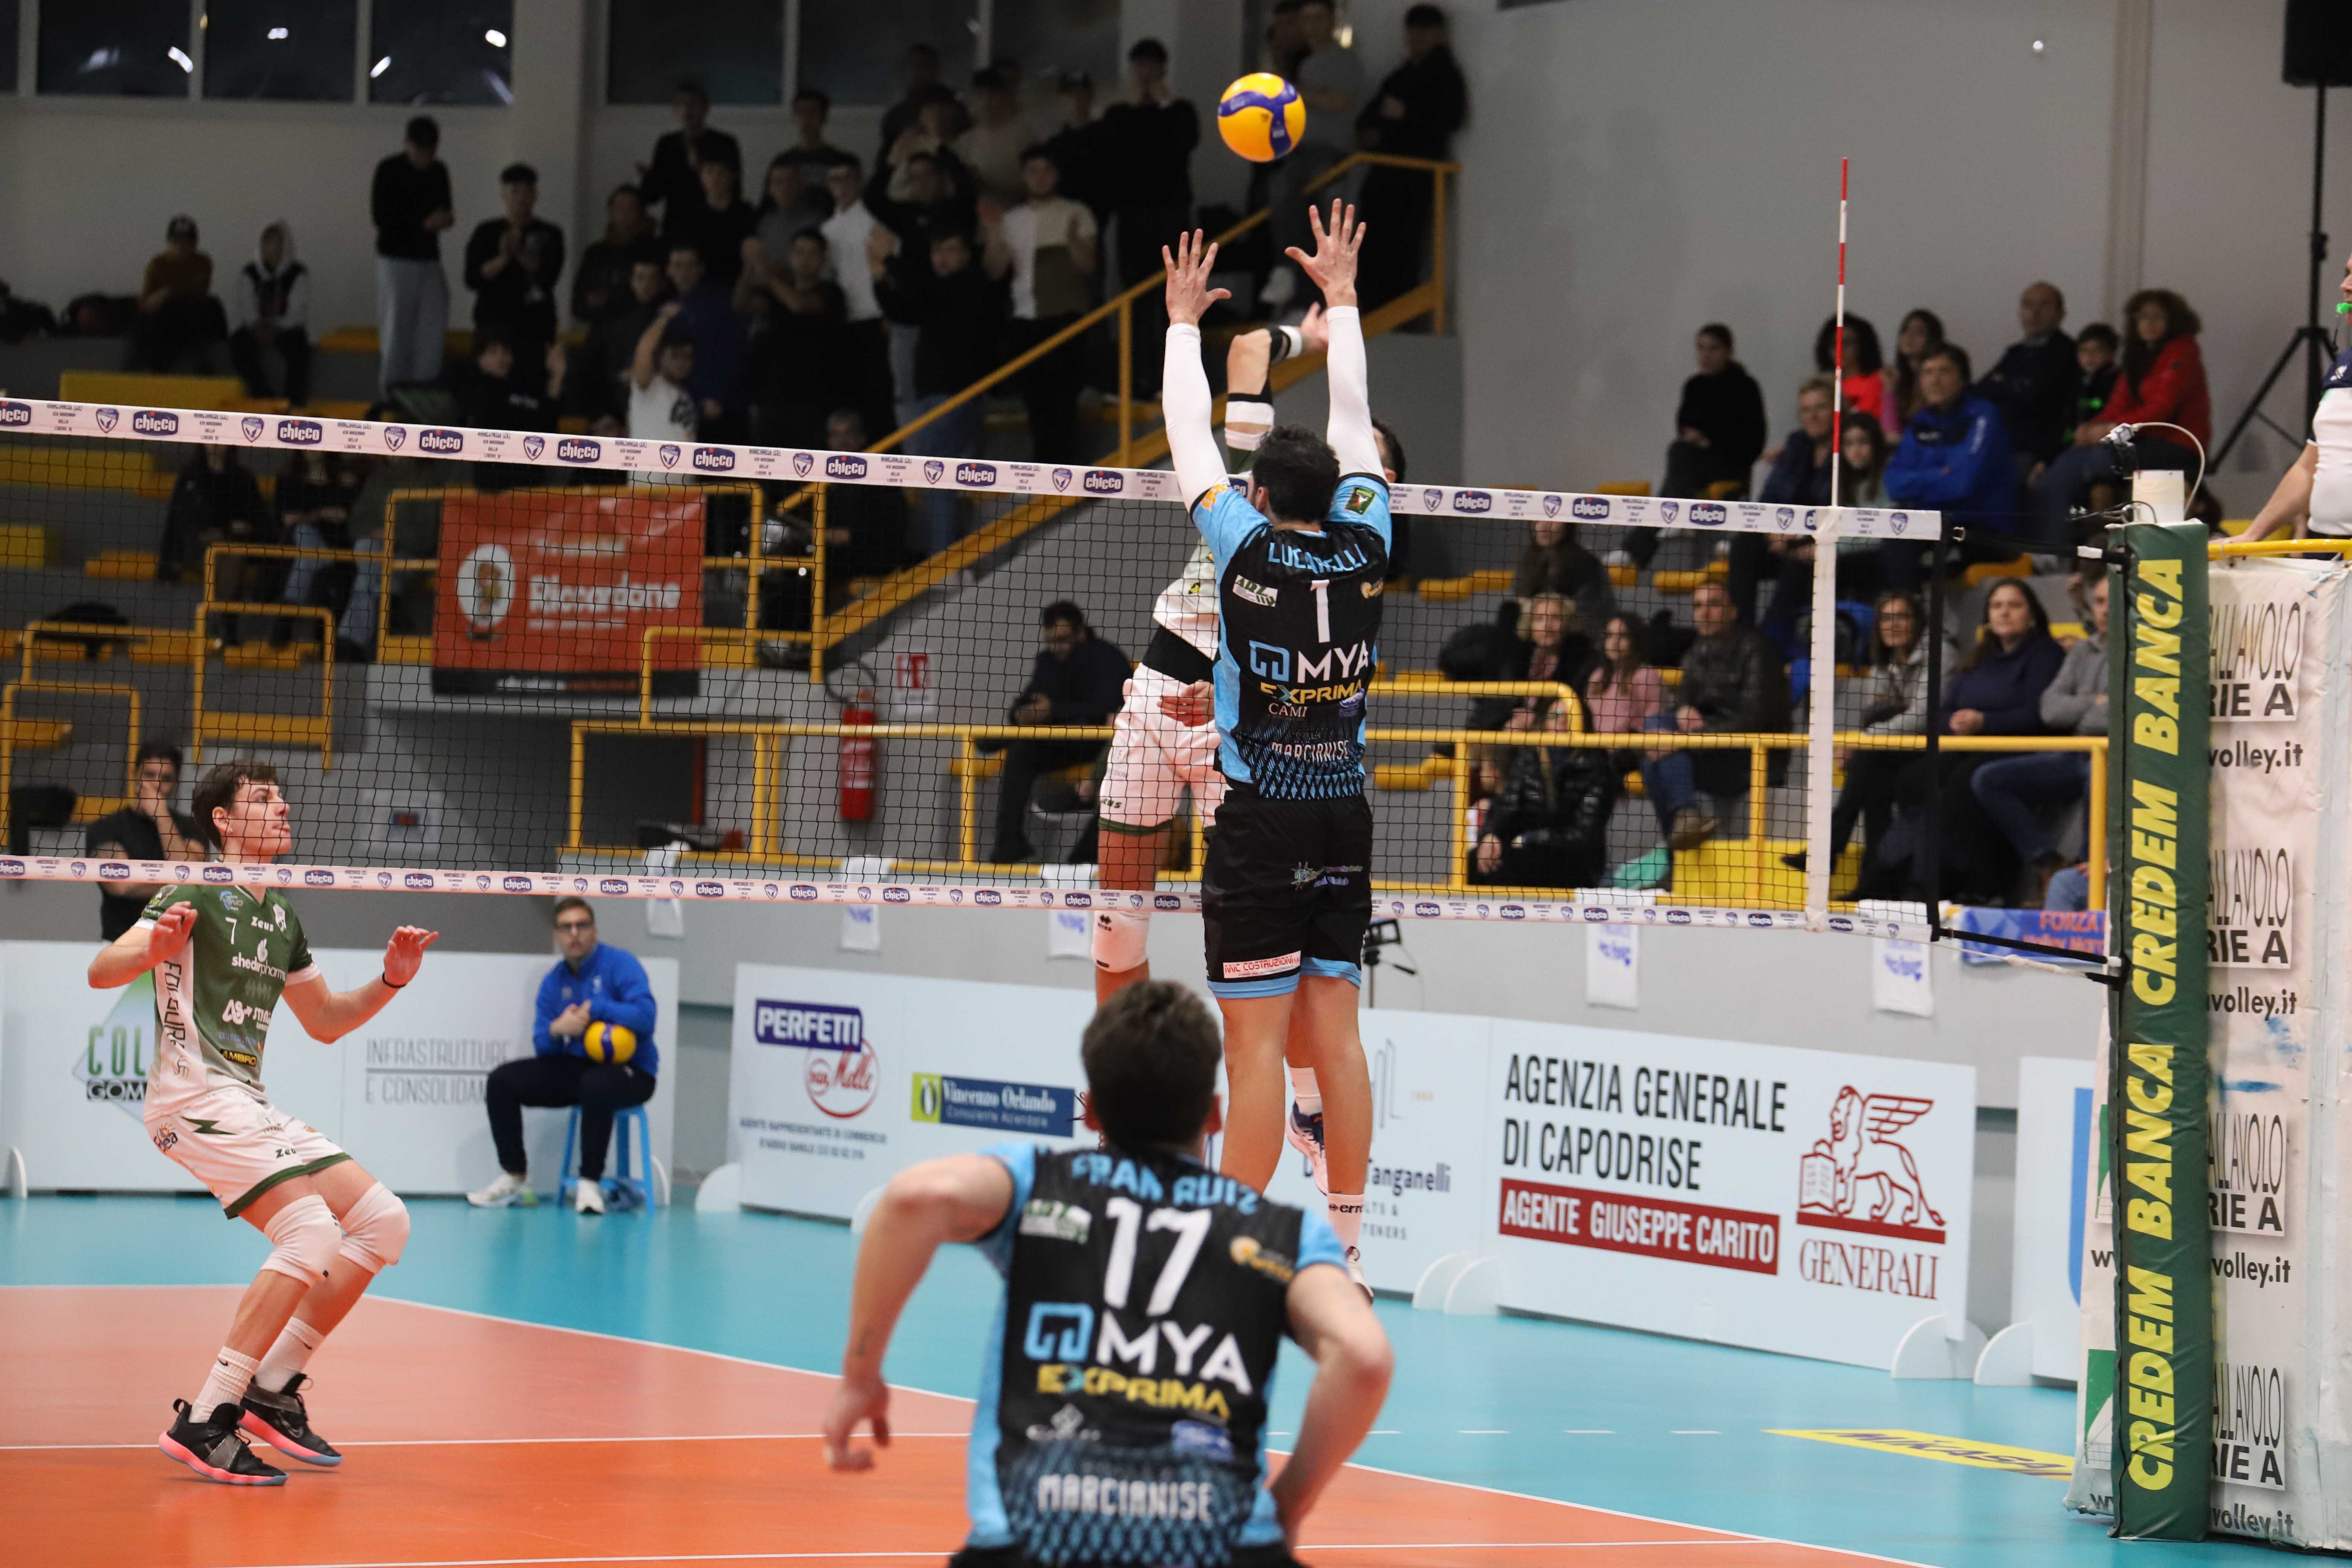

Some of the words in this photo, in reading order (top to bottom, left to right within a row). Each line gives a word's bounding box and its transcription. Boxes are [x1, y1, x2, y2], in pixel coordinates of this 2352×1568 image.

[136, 415, 175, 431] chicco
[280, 424, 319, 440] chicco
[422, 433, 460, 449] chicco
[560, 443, 598, 458] chicco
[696, 451, 732, 467] chicco
[828, 459, 864, 475] chicco
[959, 467, 994, 482] chicco
[1086, 474, 1121, 489] chicco
[1456, 494, 1489, 508] chicco
[1575, 500, 1607, 515] chicco
[1692, 507, 1724, 521] chicco
[1268, 542, 1367, 574] LUCARELLI
[1310, 579, 1330, 643] 1
[1298, 640, 1368, 683] MYA
[2133, 559, 2183, 756] BANCA
[1260, 679, 1362, 704] EXPRIMA
[2264, 683, 2294, 716] A
[1271, 740, 1349, 764] MARCIANISE
[2208, 740, 2303, 774] volley.it
[101, 866, 128, 876] chicco
[205, 870, 231, 880] chicco
[307, 873, 332, 883] chicco
[407, 876, 432, 886] chicco
[505, 879, 530, 889] chicco
[602, 882, 626, 892] chicco
[698, 884, 722, 894] chicco
[792, 888, 816, 897] chicco
[885, 890, 908, 900] chicco
[977, 893, 1000, 902] chicco
[1067, 896, 1090, 905] chicco
[2132, 780, 2177, 1006] CREDEM
[2208, 848, 2290, 928] ALLAVOLO
[1156, 897, 1179, 907] chicco
[225, 917, 237, 945] 7
[251, 916, 274, 932] Zeus
[2039, 910, 2098, 932] FORZA
[2262, 930, 2288, 963] A
[2208, 986, 2297, 1021] volley.it
[757, 1006, 861, 1046] PERFETTI
[1505, 1054, 1622, 1113] AGENZIA
[1634, 1066, 1787, 1132] GENERALE
[275, 1147, 296, 1159] Zeu
[1502, 1119, 1529, 1167] DI
[1540, 1122, 1702, 1190] CAPODRISE
[2126, 1043, 2174, 1241] BANCA
[2208, 1113, 2283, 1195] ALLAVOLO
[1072, 1154, 1164, 1201] FRAN
[1173, 1175, 1258, 1215] RUIZ
[1367, 1158, 1451, 1196] anganelli
[1503, 1189, 1580, 1235] AGENTE
[1589, 1201, 1692, 1251] GIUSEPPE
[1695, 1216, 1775, 1264] CARITO
[2257, 1196, 2283, 1231] A
[1104, 1196, 1212, 1317] 17
[1799, 1239, 1940, 1300] GENERALI
[2211, 1251, 2291, 1289] volley.it
[1096, 1309, 1253, 1394] MYA
[1037, 1364, 1230, 1419] EXPRIMA
[2127, 1265, 2175, 1490] CREDEM
[2213, 1363, 2281, 1449] ALLAVOLO
[2260, 1450, 2283, 1486] A
[1037, 1475, 1214, 1529] MARCIANISE
